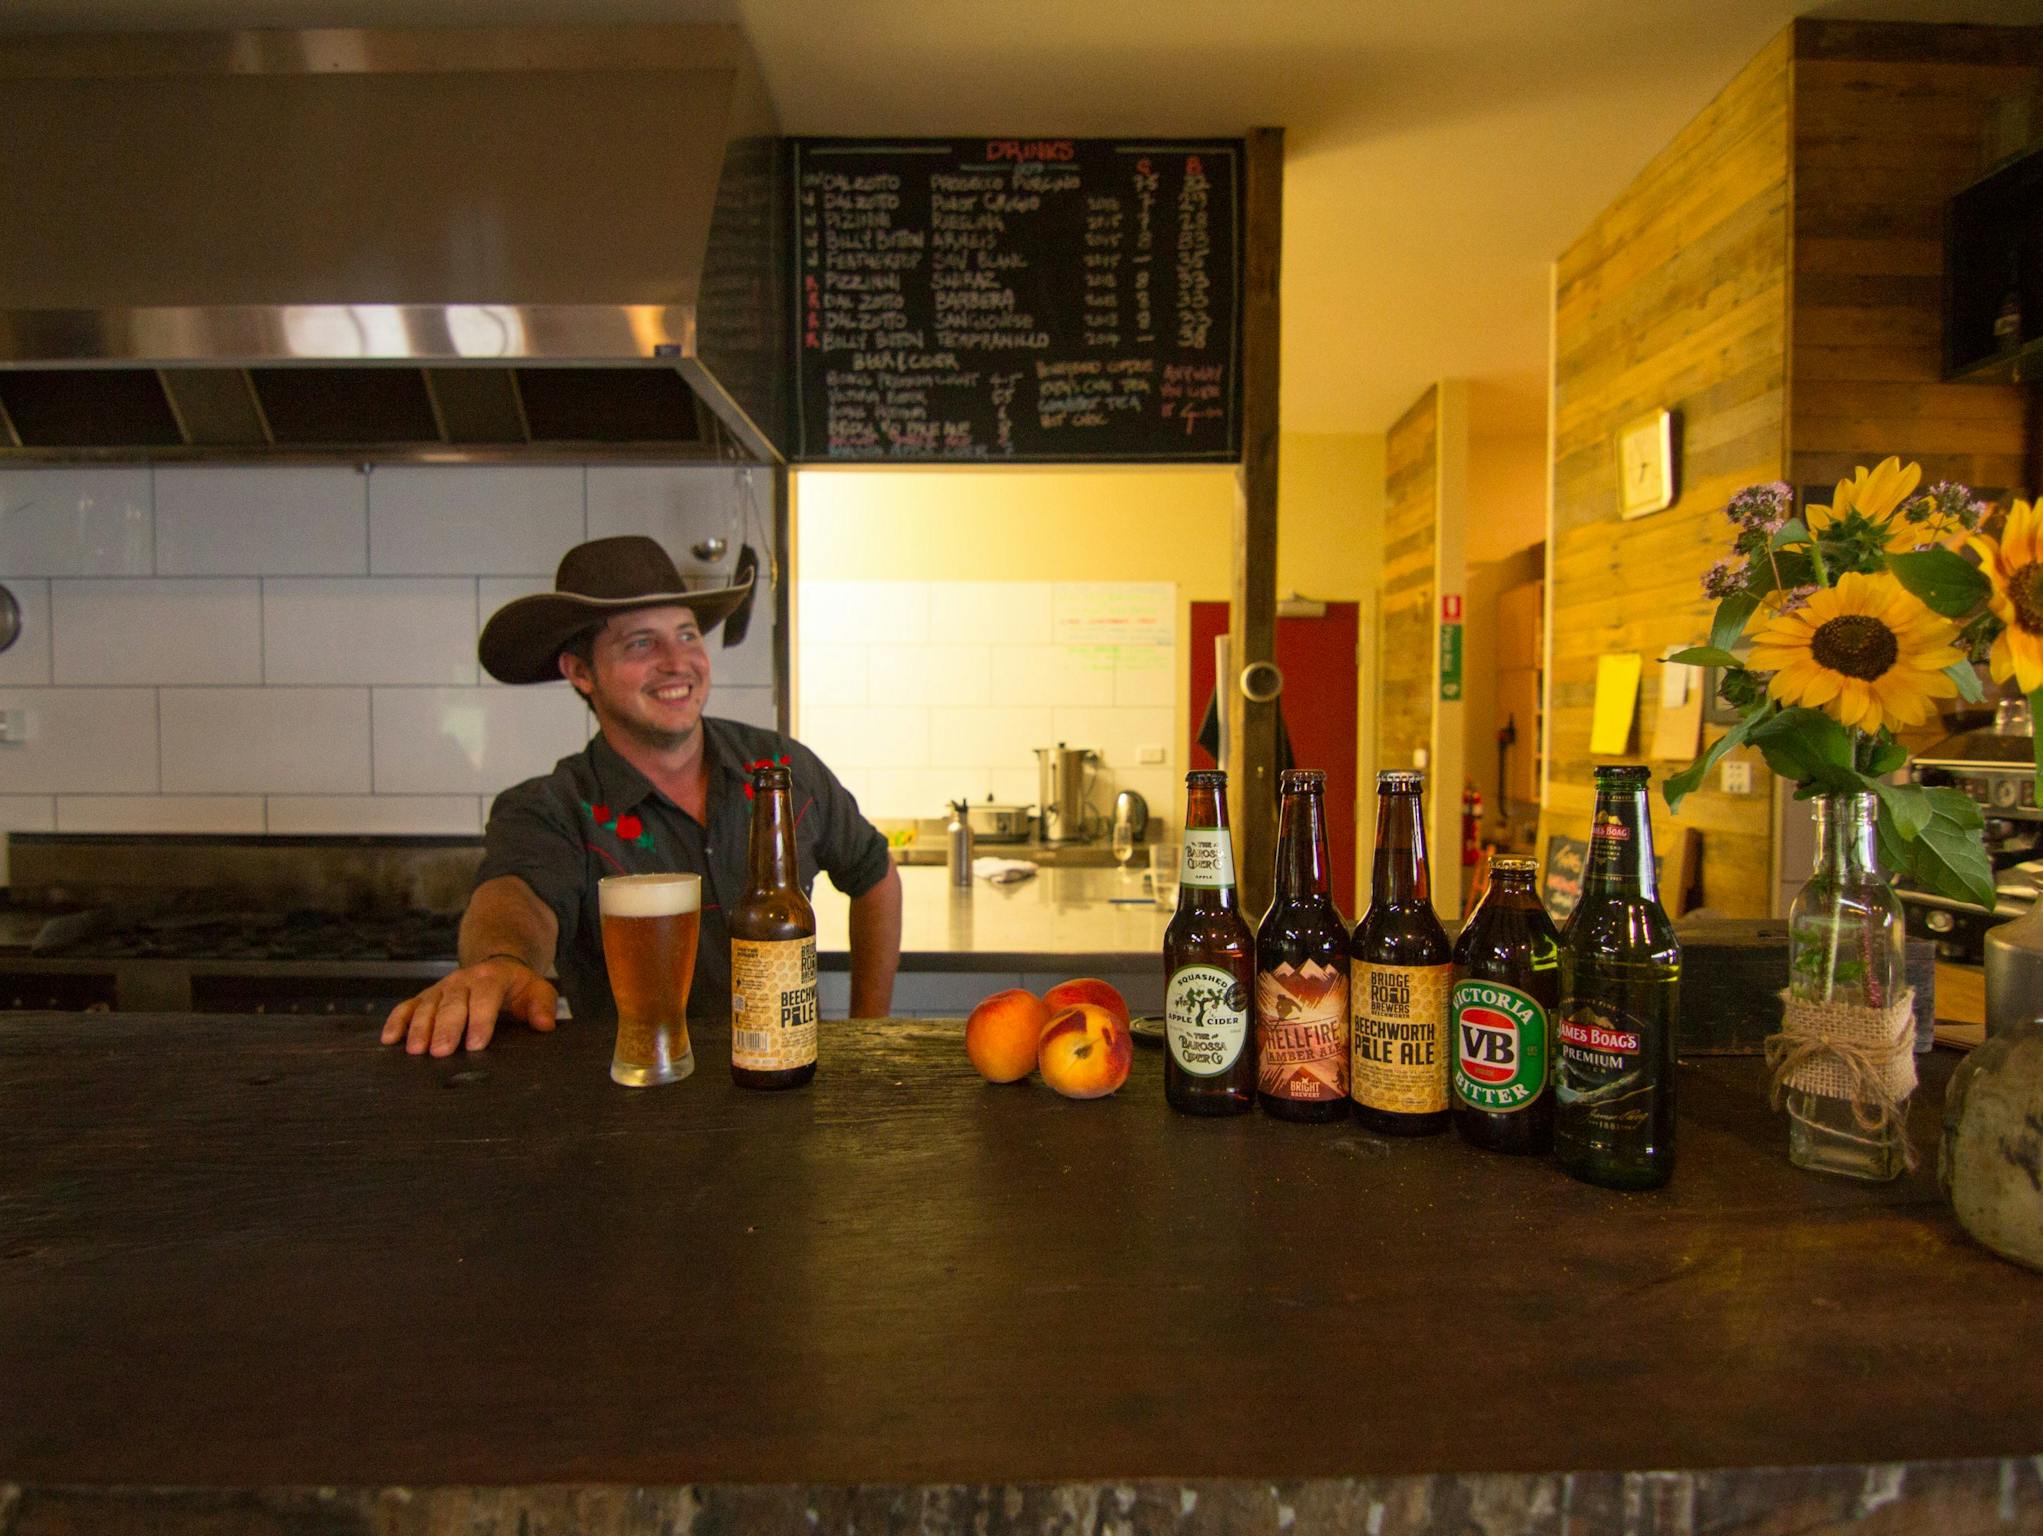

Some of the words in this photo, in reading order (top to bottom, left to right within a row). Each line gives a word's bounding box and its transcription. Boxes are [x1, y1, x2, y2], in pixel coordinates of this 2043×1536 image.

[986, 141, 1074, 163] DRINKS
[1177, 973, 1228, 988] SQUASHED
[1371, 972, 1409, 988] BRIDGE
[1371, 986, 1409, 1003] ROAD
[1371, 1002, 1410, 1014] BREWERS
[1453, 987, 1534, 1025] VICTORIA
[1168, 1012, 1193, 1024] APPLE
[1207, 1017, 1239, 1025] CIDER
[1354, 1015, 1435, 1041] BEECHWORTH
[1179, 1034, 1228, 1052] BAROSSA
[1266, 1020, 1340, 1050] HELLFIRE
[1461, 1024, 1514, 1064] VB
[1557, 1019, 1588, 1043] JAMES
[1591, 1029, 1637, 1049] BOAG'S
[1268, 1049, 1314, 1062] AMBER
[1319, 1042, 1342, 1057] ALE
[1354, 1033, 1393, 1064] PALE
[1400, 1041, 1435, 1065] ALE
[1563, 1045, 1624, 1069] PREMIUM
[1290, 1081, 1320, 1092] BRIGHT
[1455, 1069, 1530, 1104] BITTER
